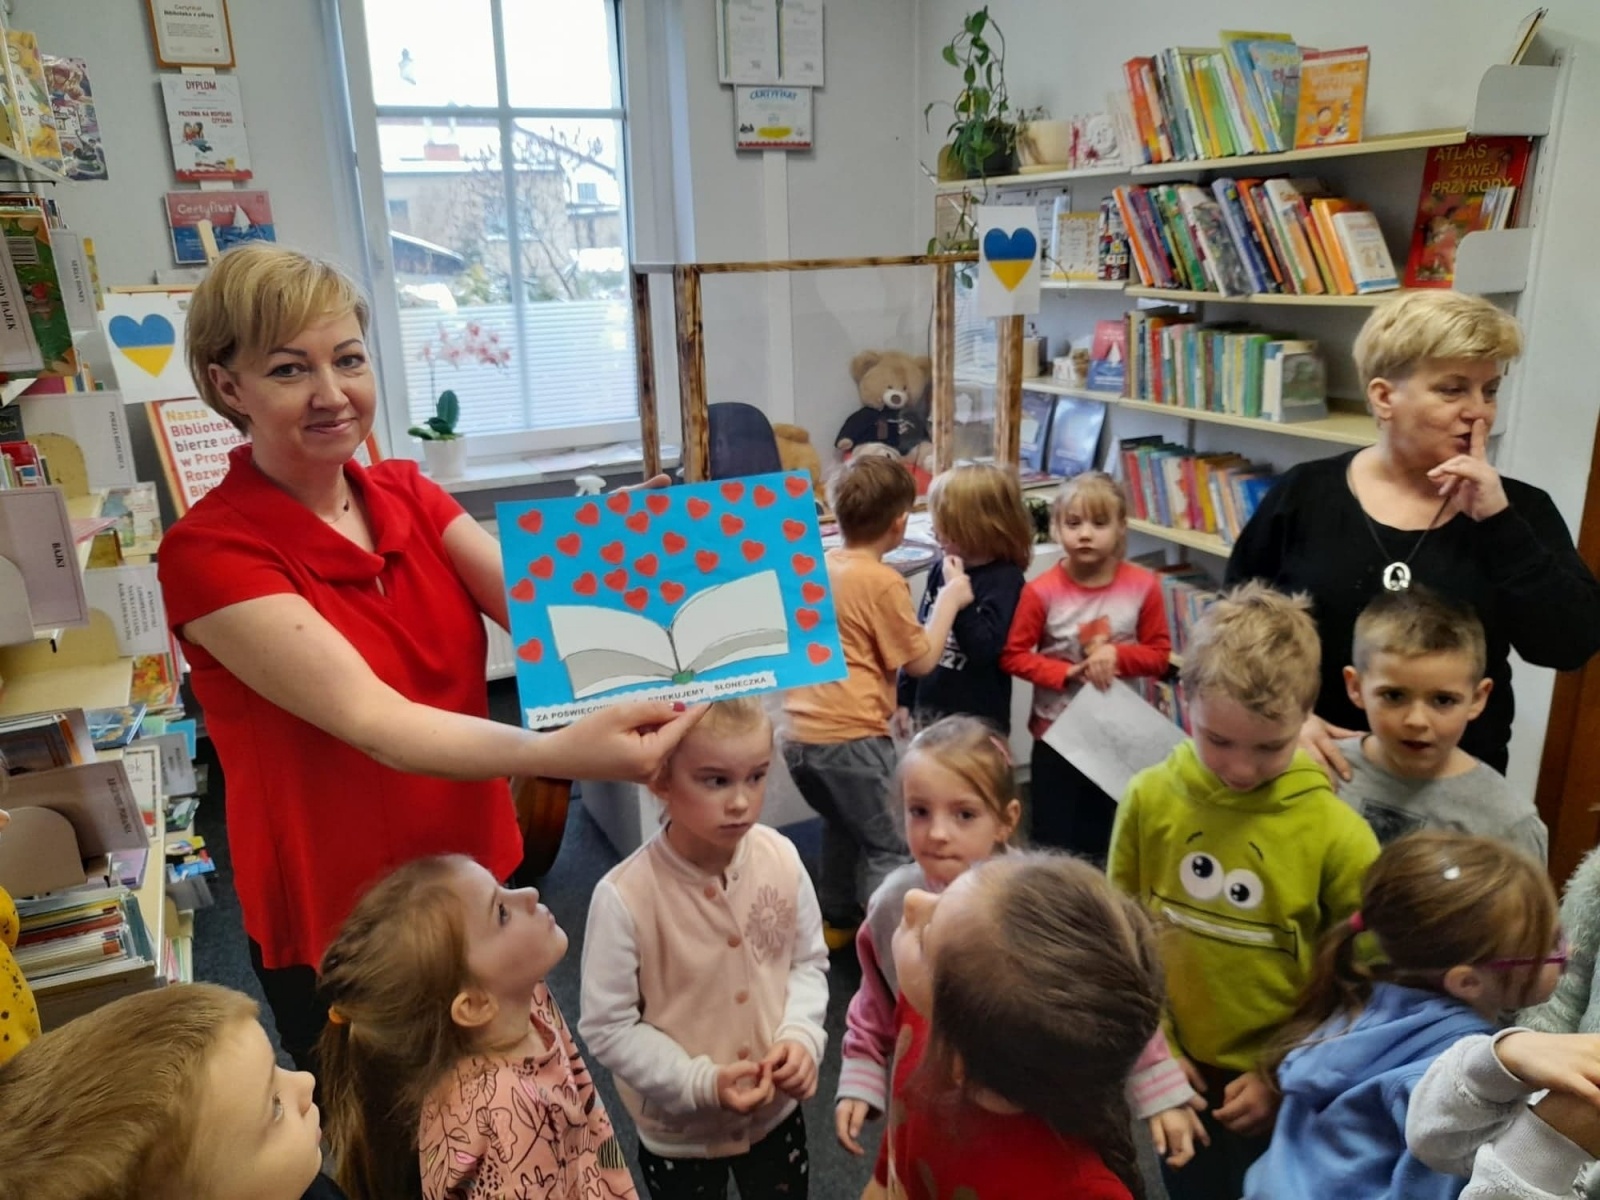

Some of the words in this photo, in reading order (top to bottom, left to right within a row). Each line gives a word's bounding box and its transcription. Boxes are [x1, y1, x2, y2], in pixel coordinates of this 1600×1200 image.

[185, 80, 217, 90] DYPLOM
[1433, 143, 1488, 161] ATLAS
[177, 200, 234, 217] Certyfikat
[1, 301, 18, 330] BAJEK
[166, 409, 208, 421] Nasza
[171, 419, 235, 437] Bibliotek
[175, 437, 218, 452] bierze
[220, 432, 245, 446] udz
[180, 457, 192, 467] w
[195, 452, 228, 465] Prog
[185, 466, 229, 482] Rozwo
[52, 542, 65, 568] BAJKI
[536, 713, 549, 722] ZA
